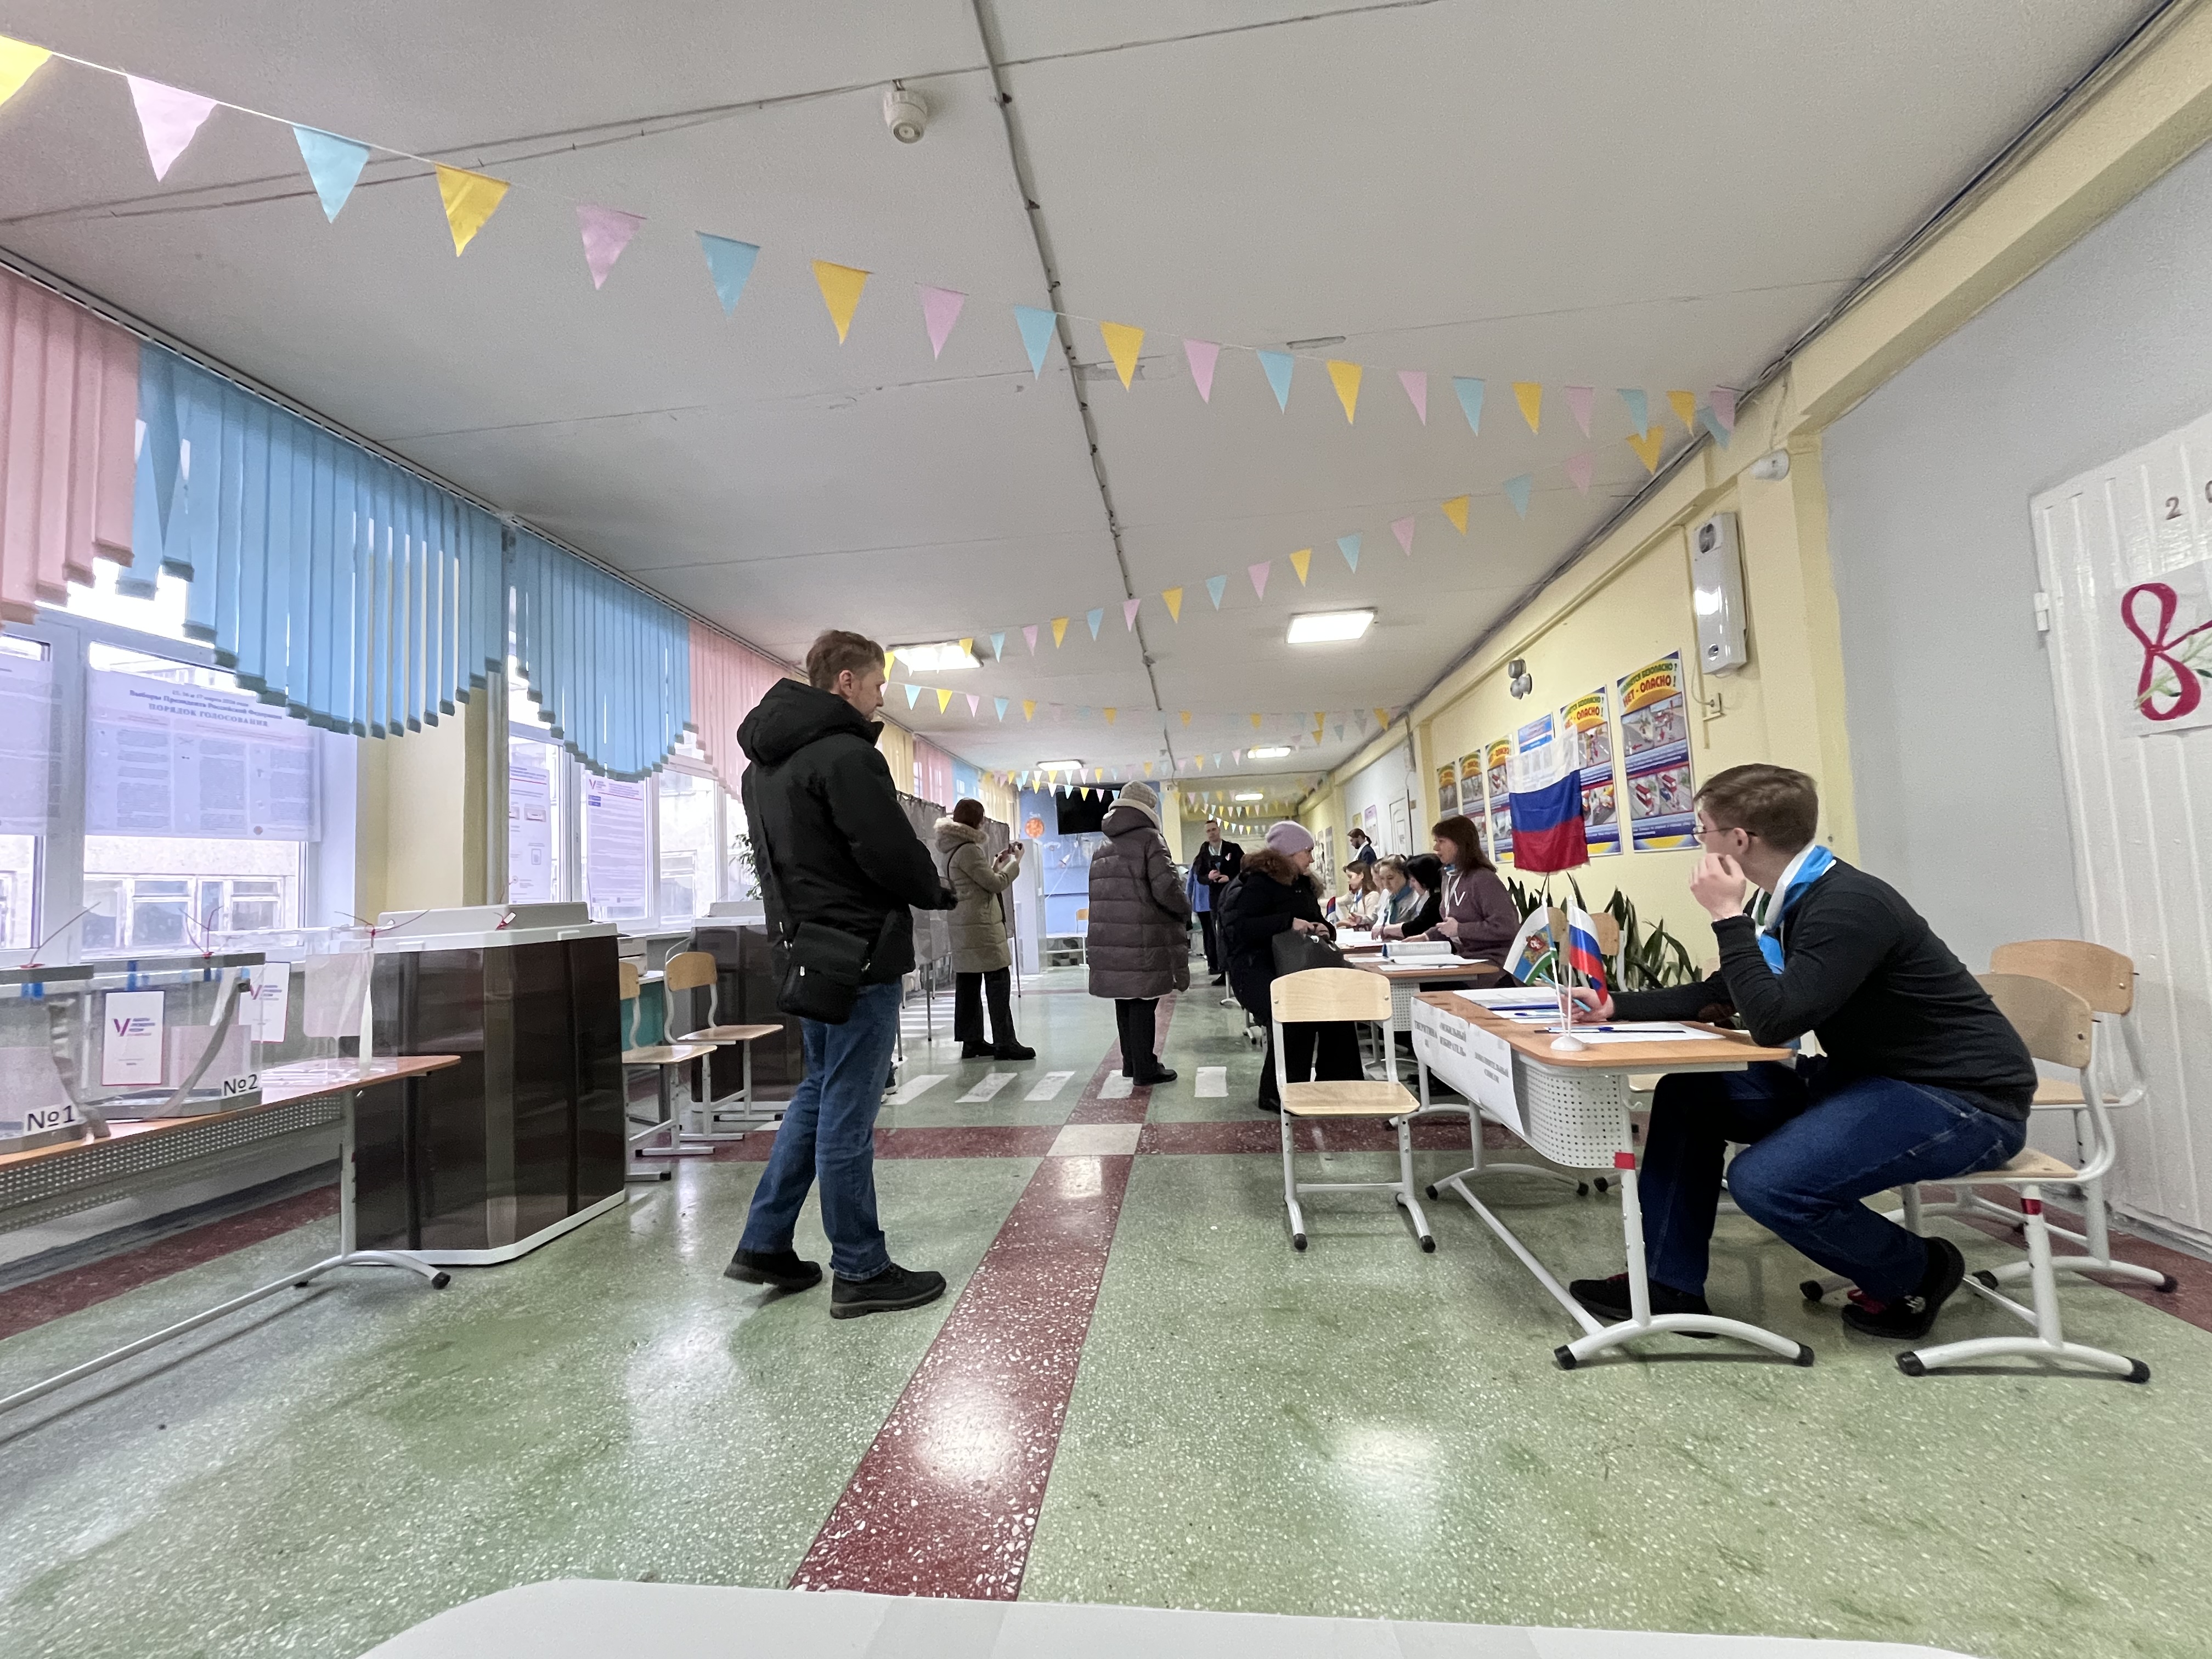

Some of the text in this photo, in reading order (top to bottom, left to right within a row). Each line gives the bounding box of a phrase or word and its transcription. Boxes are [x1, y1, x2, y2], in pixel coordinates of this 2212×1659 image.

[149, 703, 268, 726] ПОРЯДОК ГОЛОСОВАНИЯ
[224, 1074, 258, 1096] №2
[27, 1105, 75, 1131] №1
